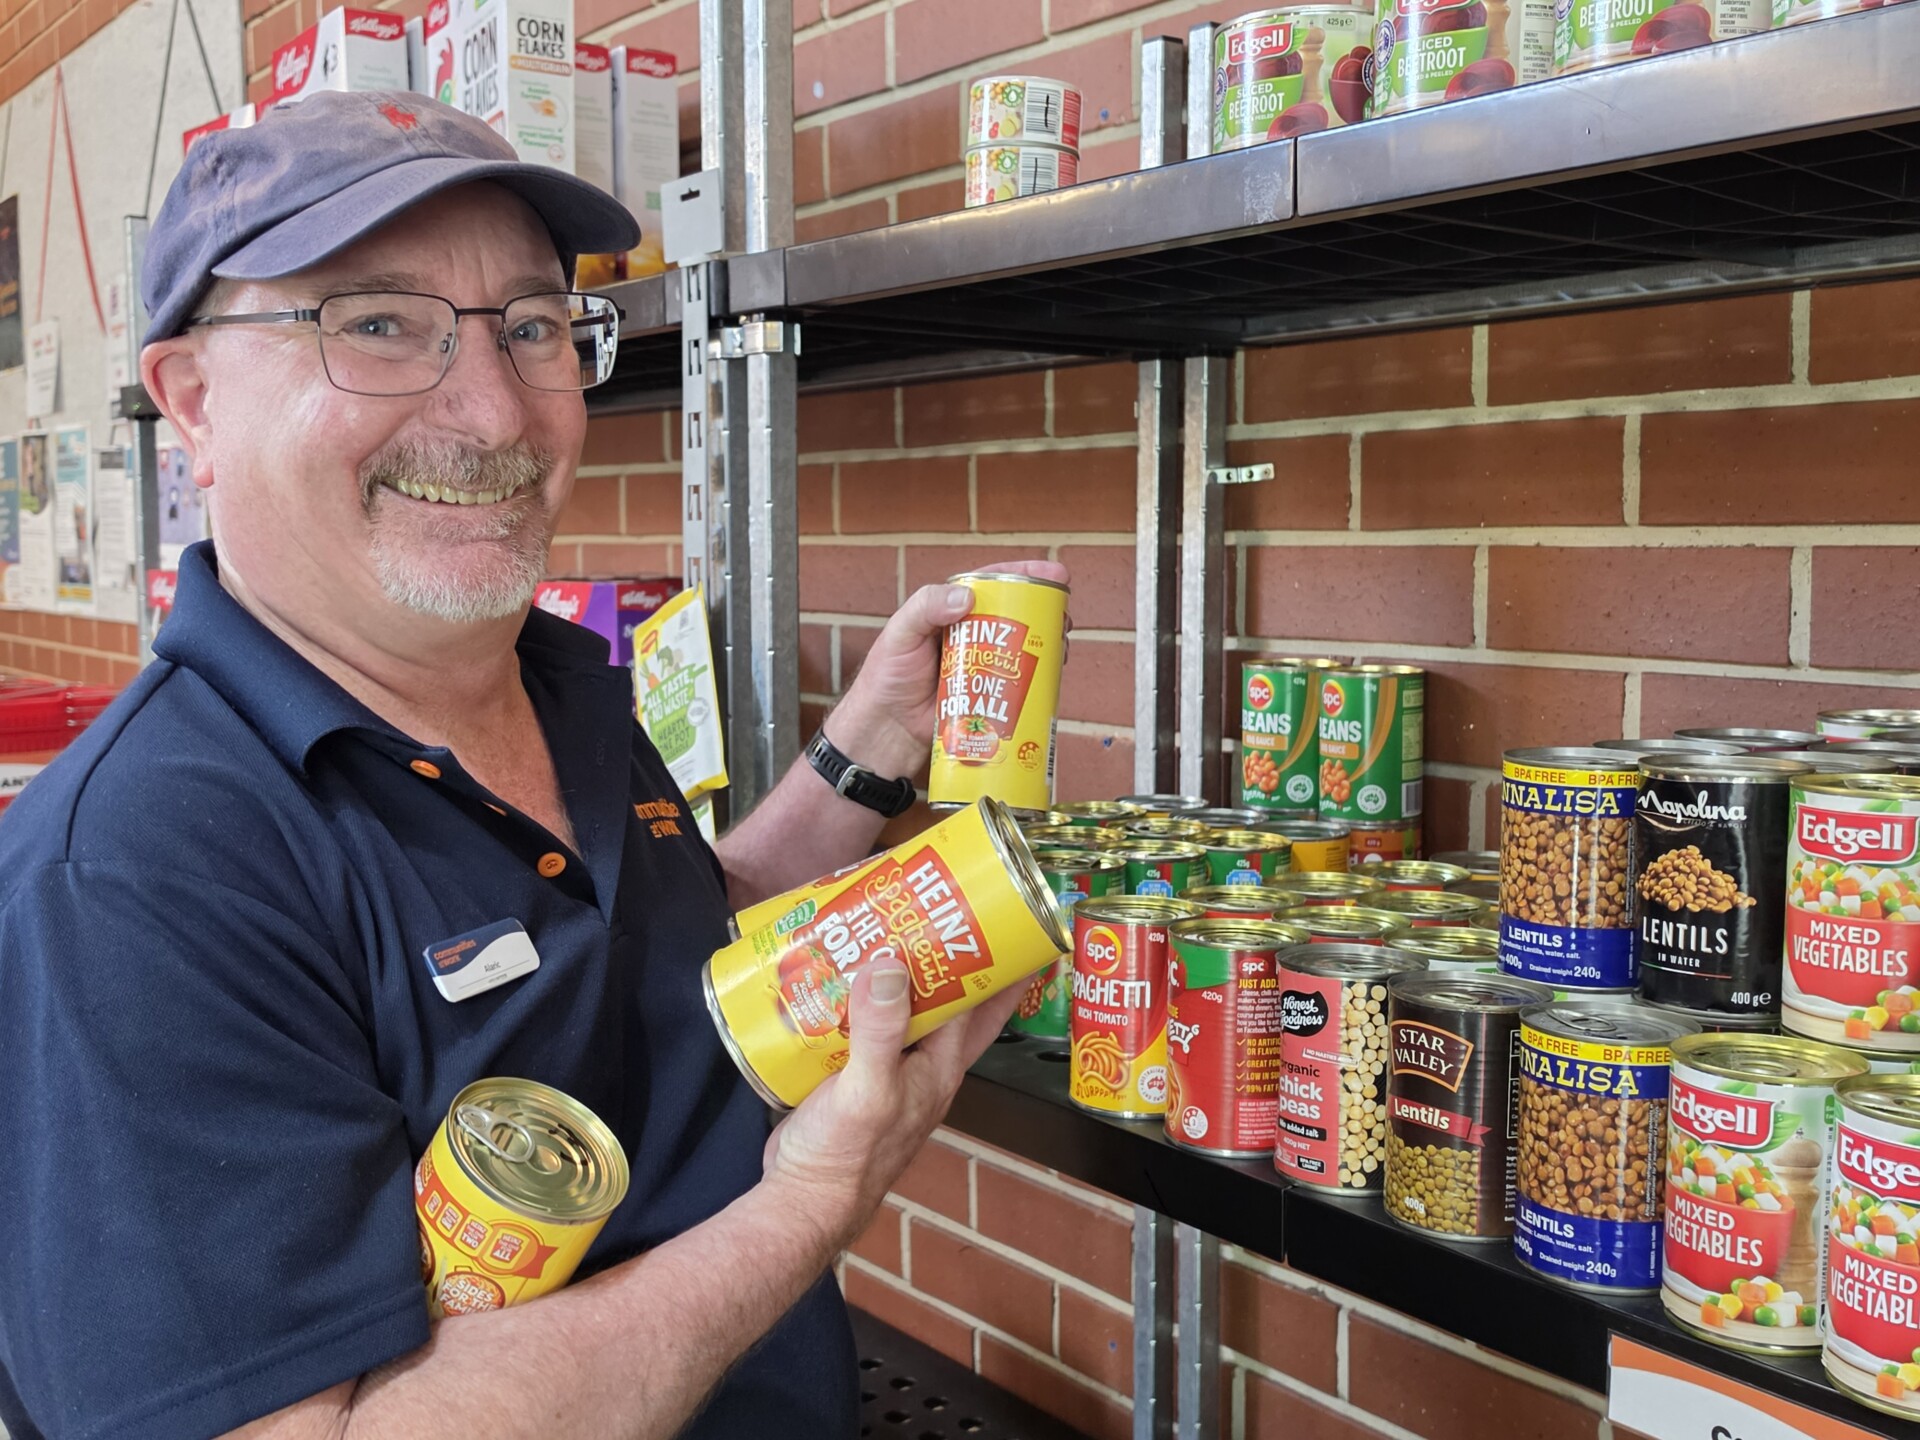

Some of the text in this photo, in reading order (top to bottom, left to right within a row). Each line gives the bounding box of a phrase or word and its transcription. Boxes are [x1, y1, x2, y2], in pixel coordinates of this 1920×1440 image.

[516, 17, 565, 43] CORN
[1326, 17, 1340, 26] 425
[463, 16, 498, 85] CORN
[517, 38, 566, 60] FLAKES
[1231, 28, 1285, 58] Edgell
[1414, 36, 1454, 53] LICED
[463, 69, 499, 115] FLAKES
[1236, 82, 1274, 99] SLCED
[1229, 92, 1285, 121] BEEROOT
[949, 620, 1014, 648] HEINZ
[945, 673, 1007, 699] THE ONE
[1250, 686, 1270, 702] spc
[940, 694, 1009, 723] FOR ALL
[1323, 693, 1340, 708] spc
[1242, 708, 1292, 735] BEANS
[1514, 767, 1639, 786] BPA FREE BPA FRE
[1502, 781, 1620, 815] NNALISA
[1637, 789, 1748, 824] Napolina
[1801, 811, 1904, 856] Edgell
[1146, 869, 1161, 878] 425g
[1236, 859, 1250, 868] 425g
[905, 859, 981, 962] HEINZ
[845, 902, 887, 951] THE
[1148, 931, 1165, 943] 420g
[1508, 925, 1563, 948] LENTILS
[1642, 915, 1729, 955] LENTILS
[1809, 919, 1881, 946] MIXED
[814, 910, 863, 972] FOR
[1086, 942, 1117, 964] spc
[1241, 960, 1265, 975] spc
[1505, 953, 1523, 970] 400g
[1573, 966, 1601, 980] 240g
[1657, 951, 1701, 968] IN WATER
[1793, 933, 1909, 979] VEGETABLES
[970, 974, 988, 991] 1869
[1072, 967, 1151, 1010] SPAGHETTI
[1238, 978, 1258, 989] JUST
[1201, 990, 1224, 1004] 420g
[1282, 995, 1319, 1015] Honest
[1730, 991, 1751, 1005] 400
[1078, 1006, 1129, 1027] RICH TOMATO
[1246, 1038, 1257, 1047] NO
[1246, 1047, 1257, 1056] OR
[1399, 1027, 1447, 1055] STAR
[1527, 1030, 1543, 1049] BPA
[1546, 1038, 1579, 1057] FREE
[1603, 1048, 1632, 1063] BPA
[1636, 1050, 1671, 1063] FREE
[1246, 1059, 1268, 1068] GREAT
[1394, 1048, 1455, 1078] VALLEY
[1245, 1083, 1275, 1093] 99% FAT
[1246, 1072, 1270, 1081] LOW IN
[1279, 1074, 1324, 1103] chick
[1279, 1094, 1321, 1120] peas
[1394, 1097, 1451, 1131] Lentils
[1671, 1082, 1758, 1136] Edgell
[1286, 1123, 1305, 1135] added
[1305, 1128, 1319, 1138] salt
[1297, 1141, 1311, 1151] NET
[1839, 1131, 1920, 1189] Edge
[1404, 1195, 1426, 1215] 400g
[1674, 1194, 1736, 1231] MIXED
[1520, 1205, 1575, 1239] LENTILS
[461, 1232, 479, 1248] TWO
[1577, 1244, 1595, 1254] salt.
[1665, 1207, 1764, 1267] VEGETABLES
[492, 1249, 510, 1262] ALL
[1539, 1251, 1562, 1266] Drained
[1562, 1261, 1586, 1272] weight
[1586, 1260, 1617, 1278] 240g
[1844, 1253, 1918, 1294] MIXED
[442, 1281, 470, 1303] FOR
[457, 1279, 495, 1303] SIDES
[1831, 1266, 1920, 1331] VEGETABL
